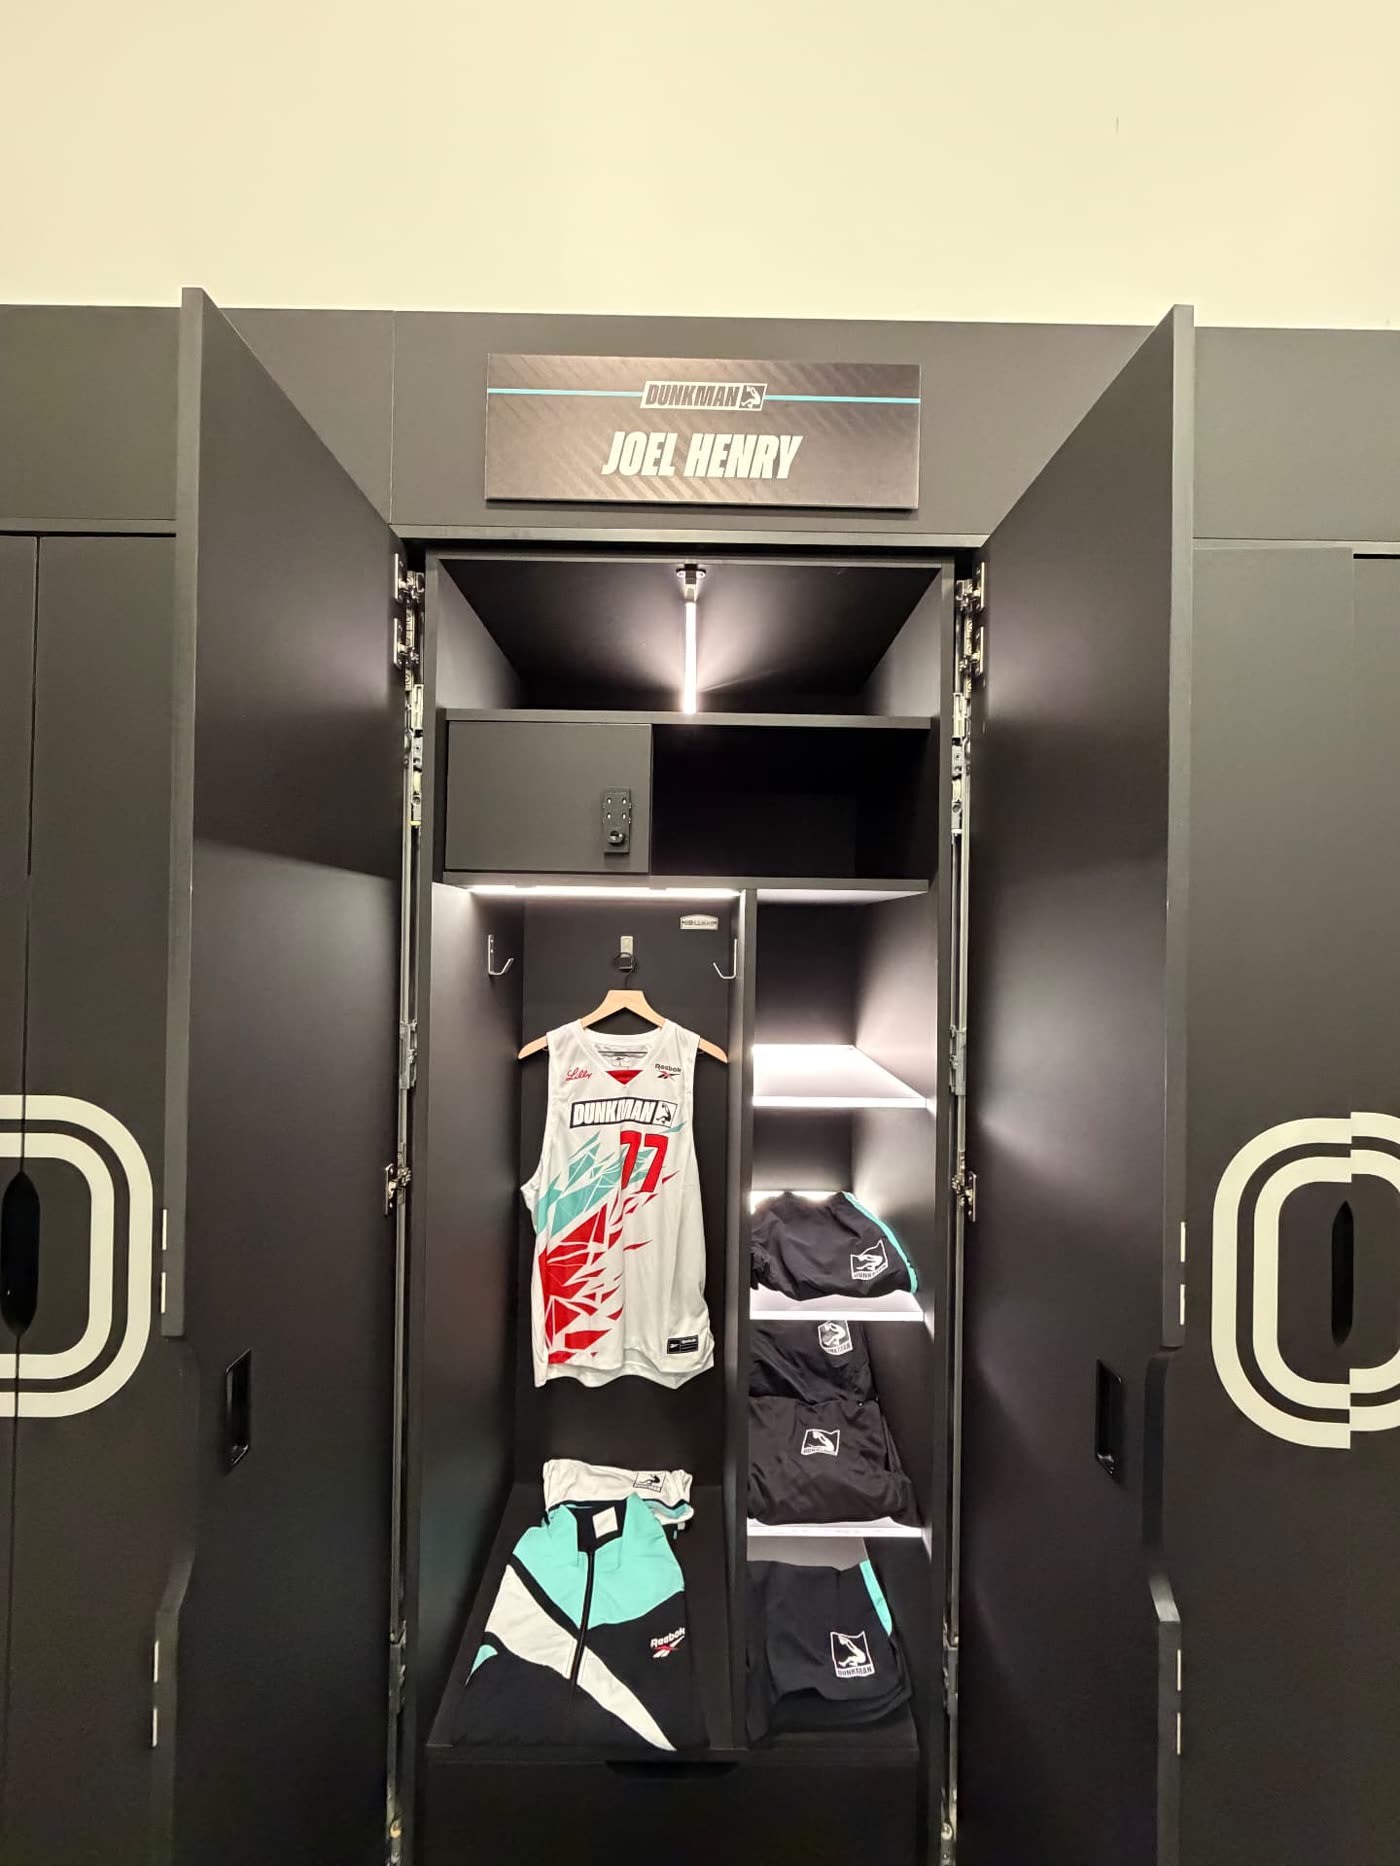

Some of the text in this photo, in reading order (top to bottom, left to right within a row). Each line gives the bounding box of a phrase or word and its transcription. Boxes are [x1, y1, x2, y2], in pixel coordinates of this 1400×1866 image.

[645, 384, 741, 408] DUNKMAN
[601, 431, 803, 479] JOEL HENRY
[573, 1099, 655, 1126] DUNKMAN
[619, 1129, 669, 1193] 77
[650, 1627, 686, 1648] Reebok
